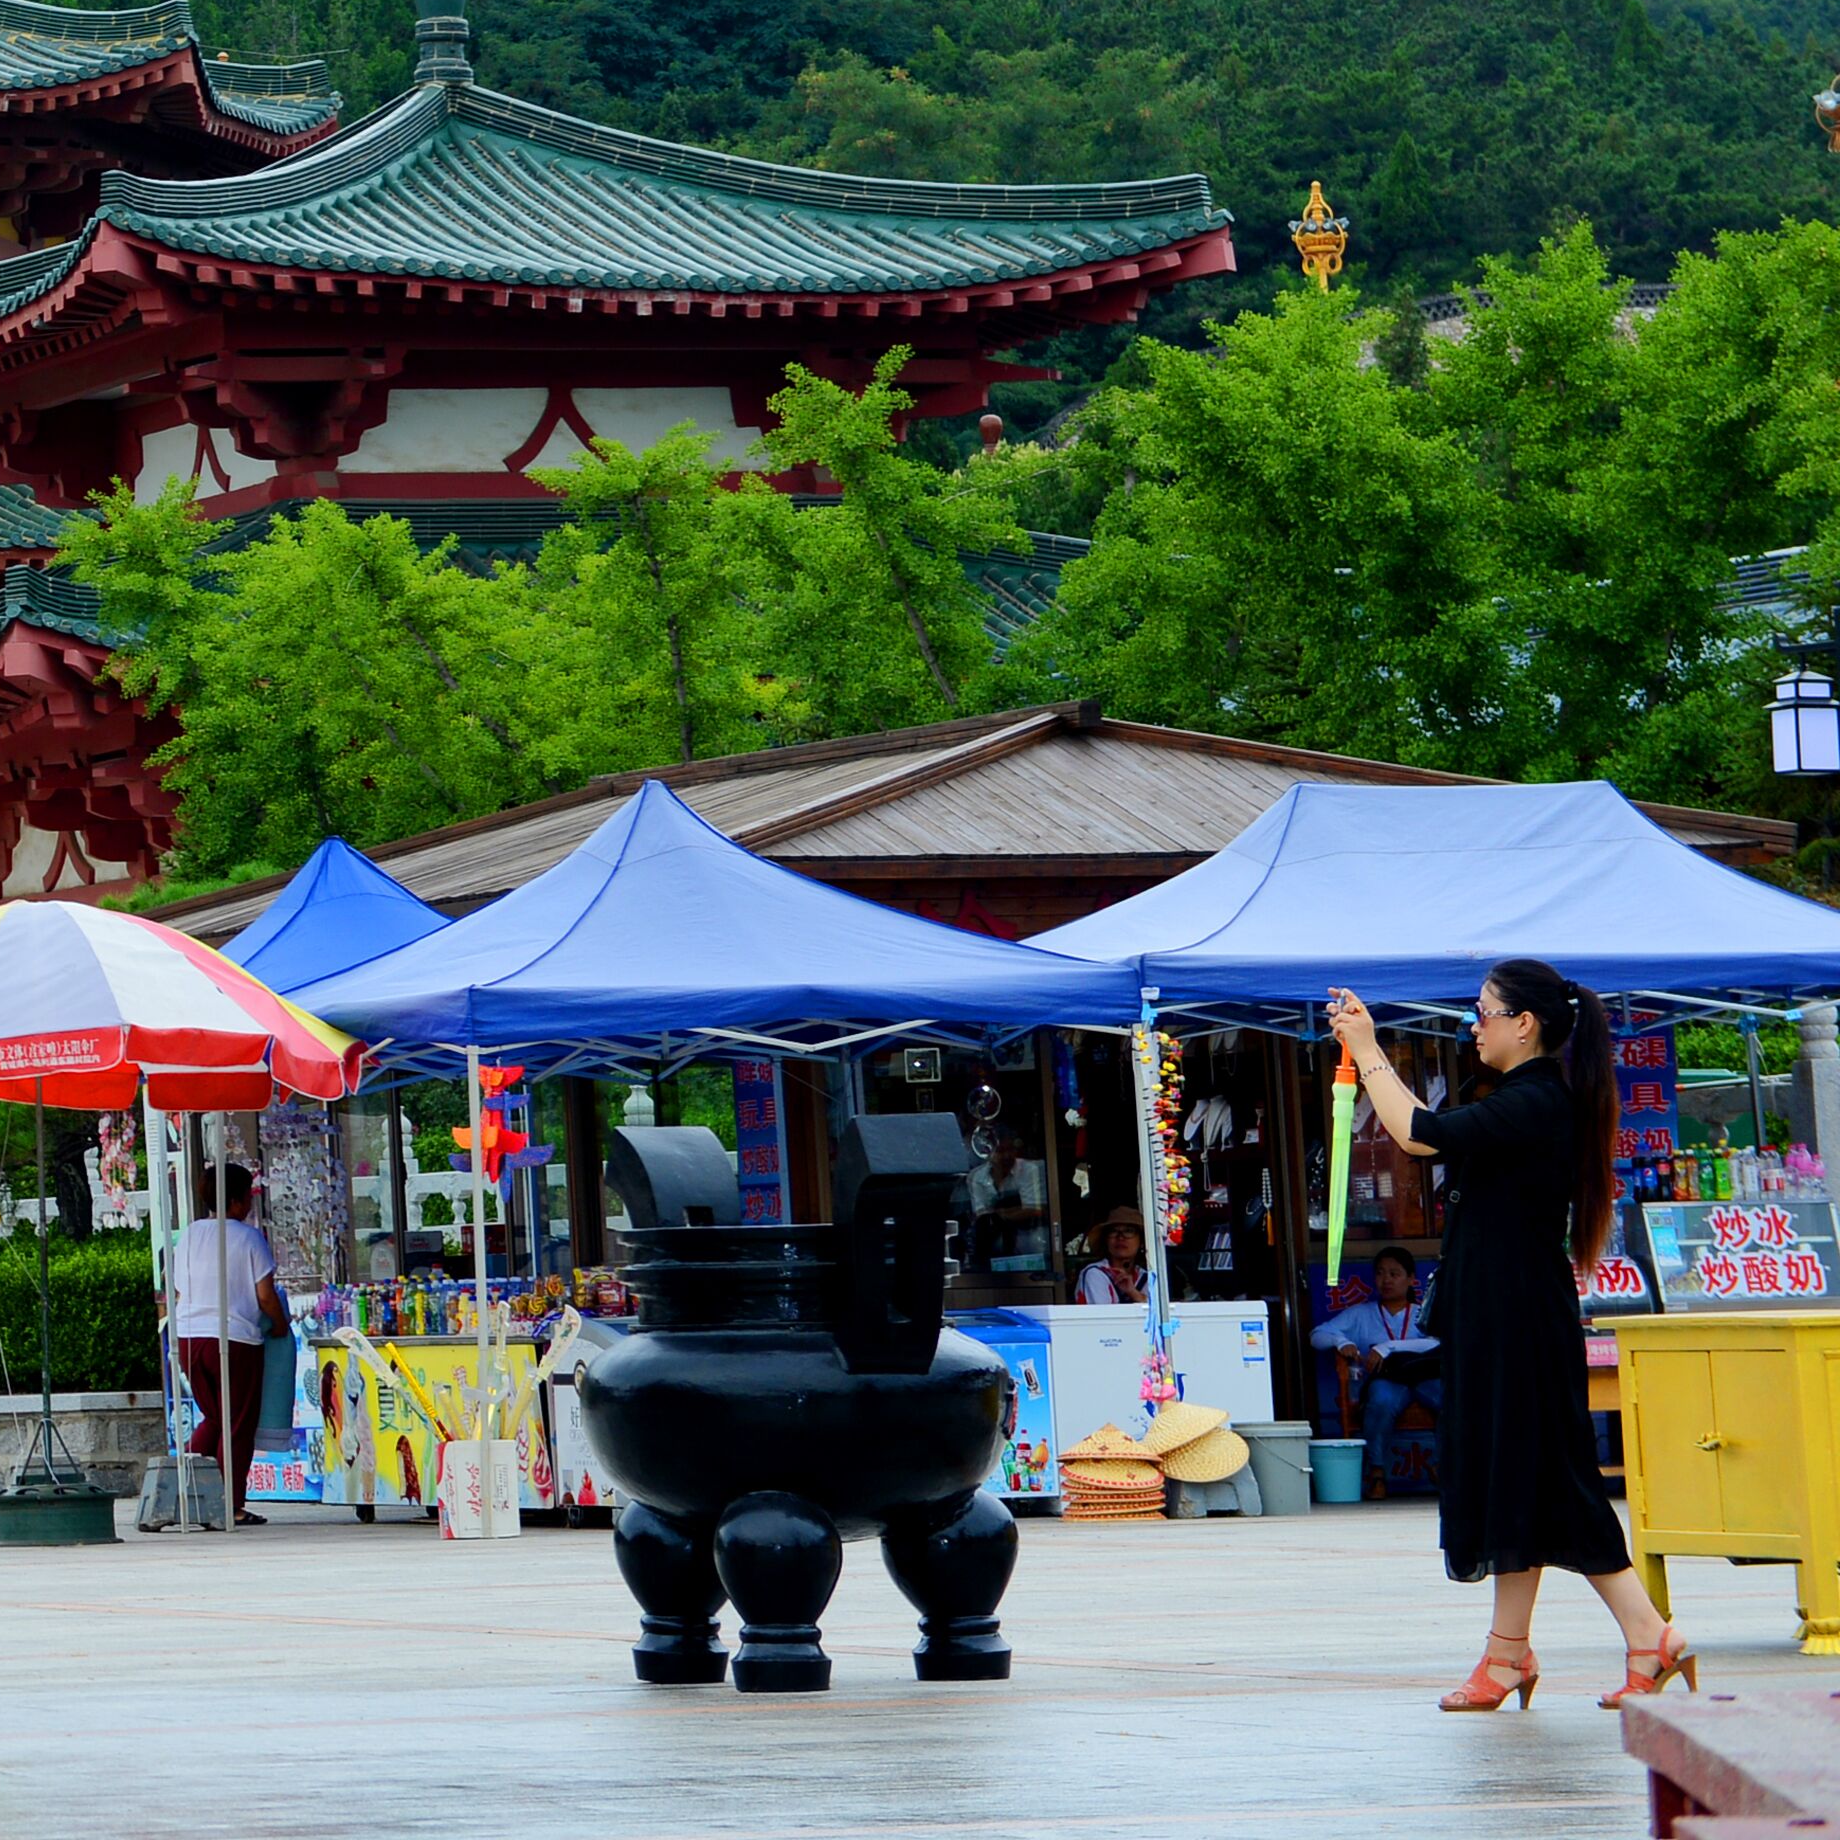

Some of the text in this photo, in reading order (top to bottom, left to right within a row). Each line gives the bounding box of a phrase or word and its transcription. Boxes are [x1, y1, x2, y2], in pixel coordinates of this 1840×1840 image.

[1713, 1208, 1794, 1248] 炒冰
[1700, 1254, 1824, 1294] 炒酸奶
